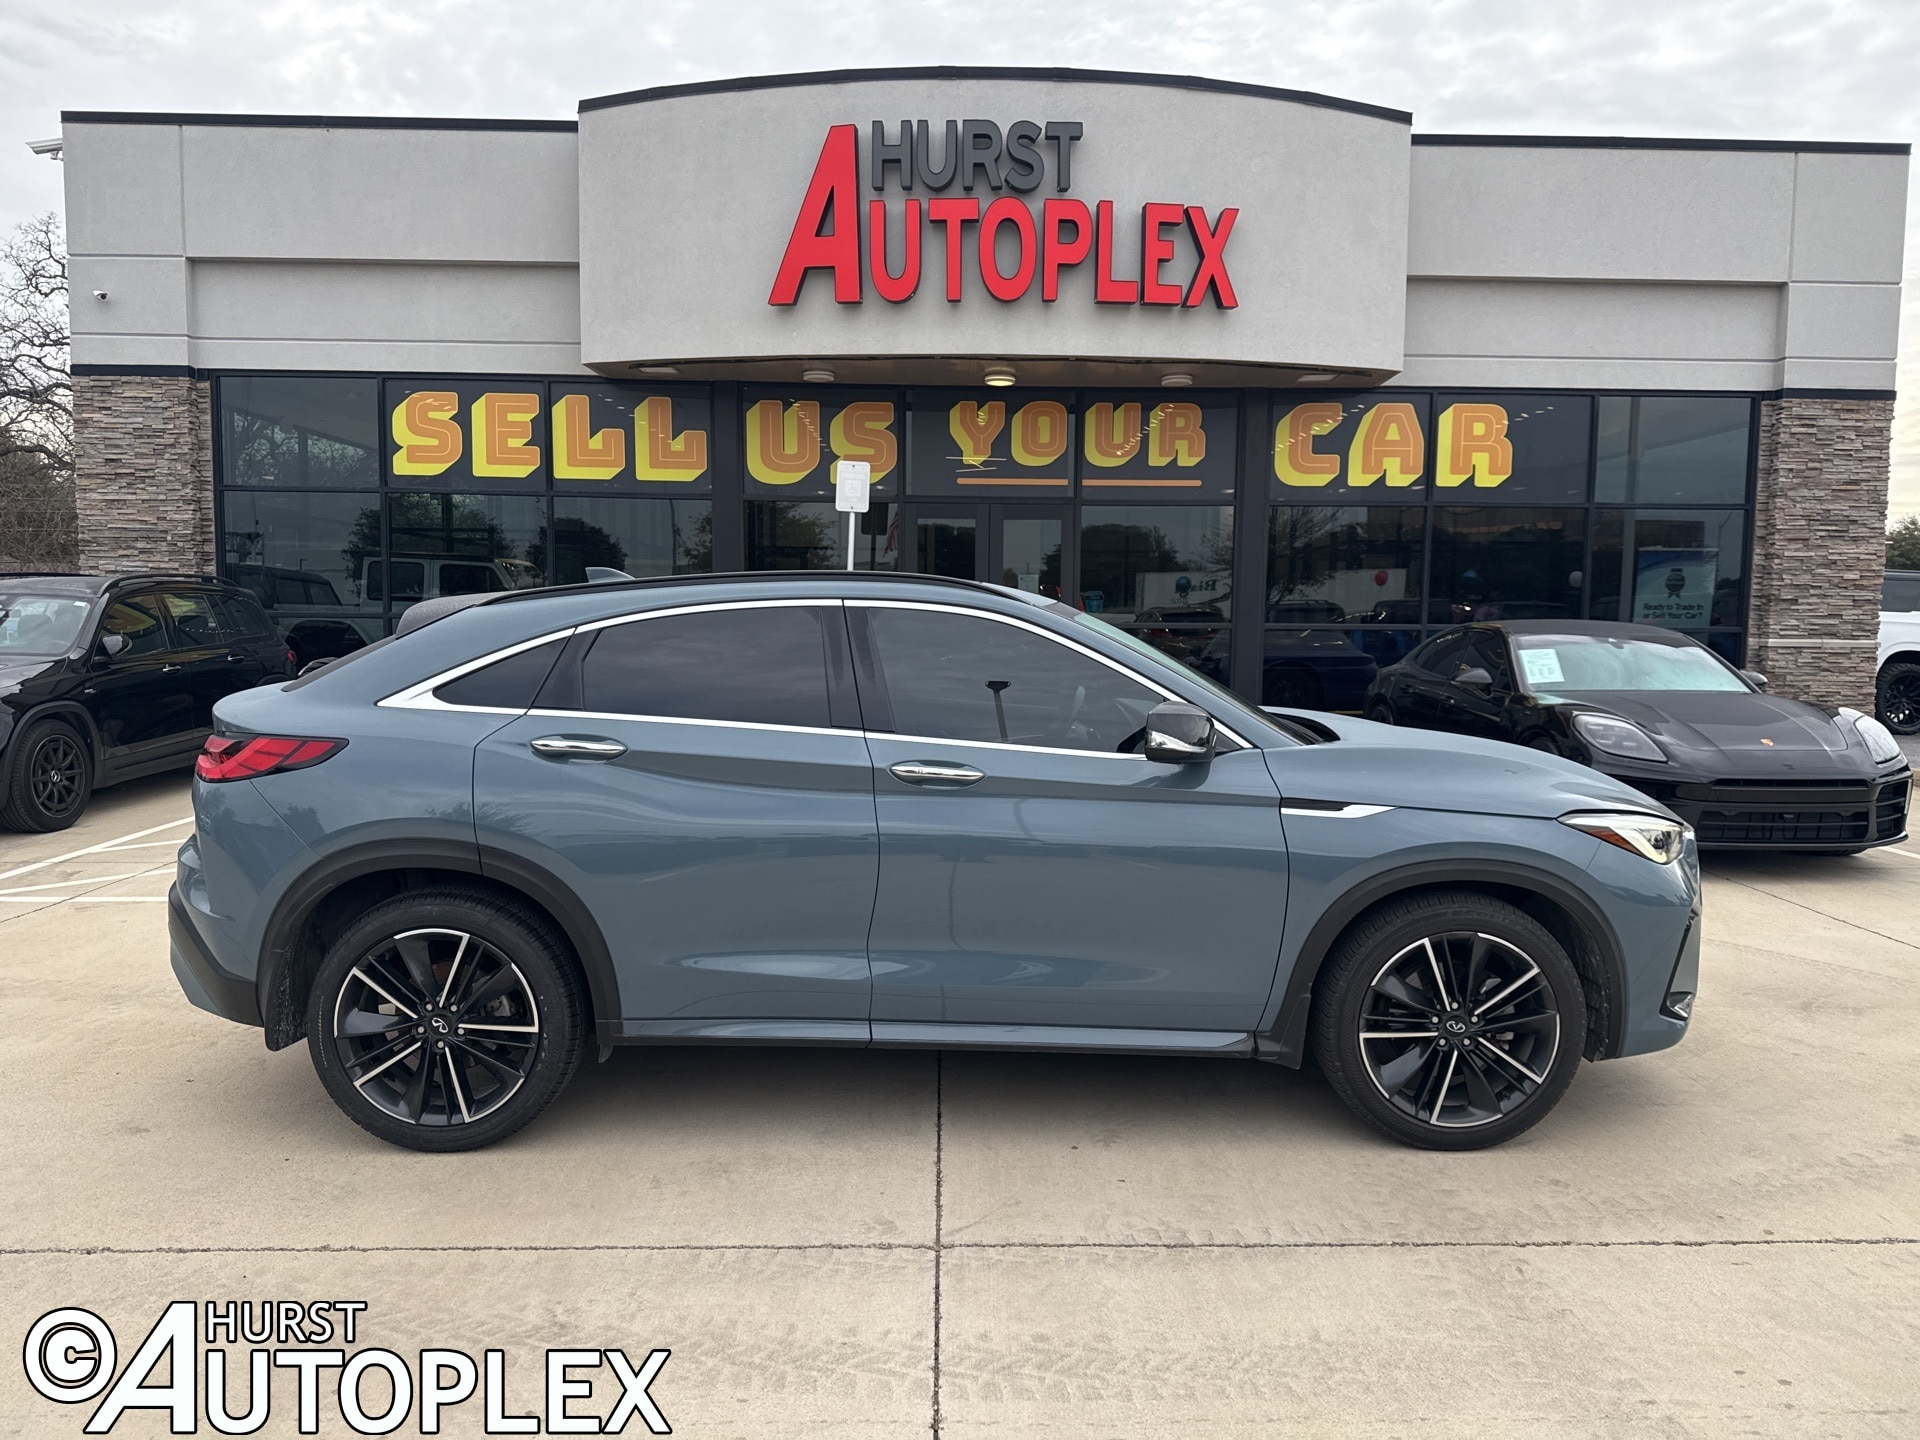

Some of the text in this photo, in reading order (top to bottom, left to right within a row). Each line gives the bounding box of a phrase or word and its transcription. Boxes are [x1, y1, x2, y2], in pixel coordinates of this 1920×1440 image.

[871, 119, 1083, 193] HURST
[768, 124, 1239, 309] AUTOPLEX
[391, 391, 1513, 487] SELL US YOUR CAR
[1643, 603, 1665, 611] Ready
[1652, 611, 1666, 619] Sell
[1684, 611, 1703, 619] Car?
